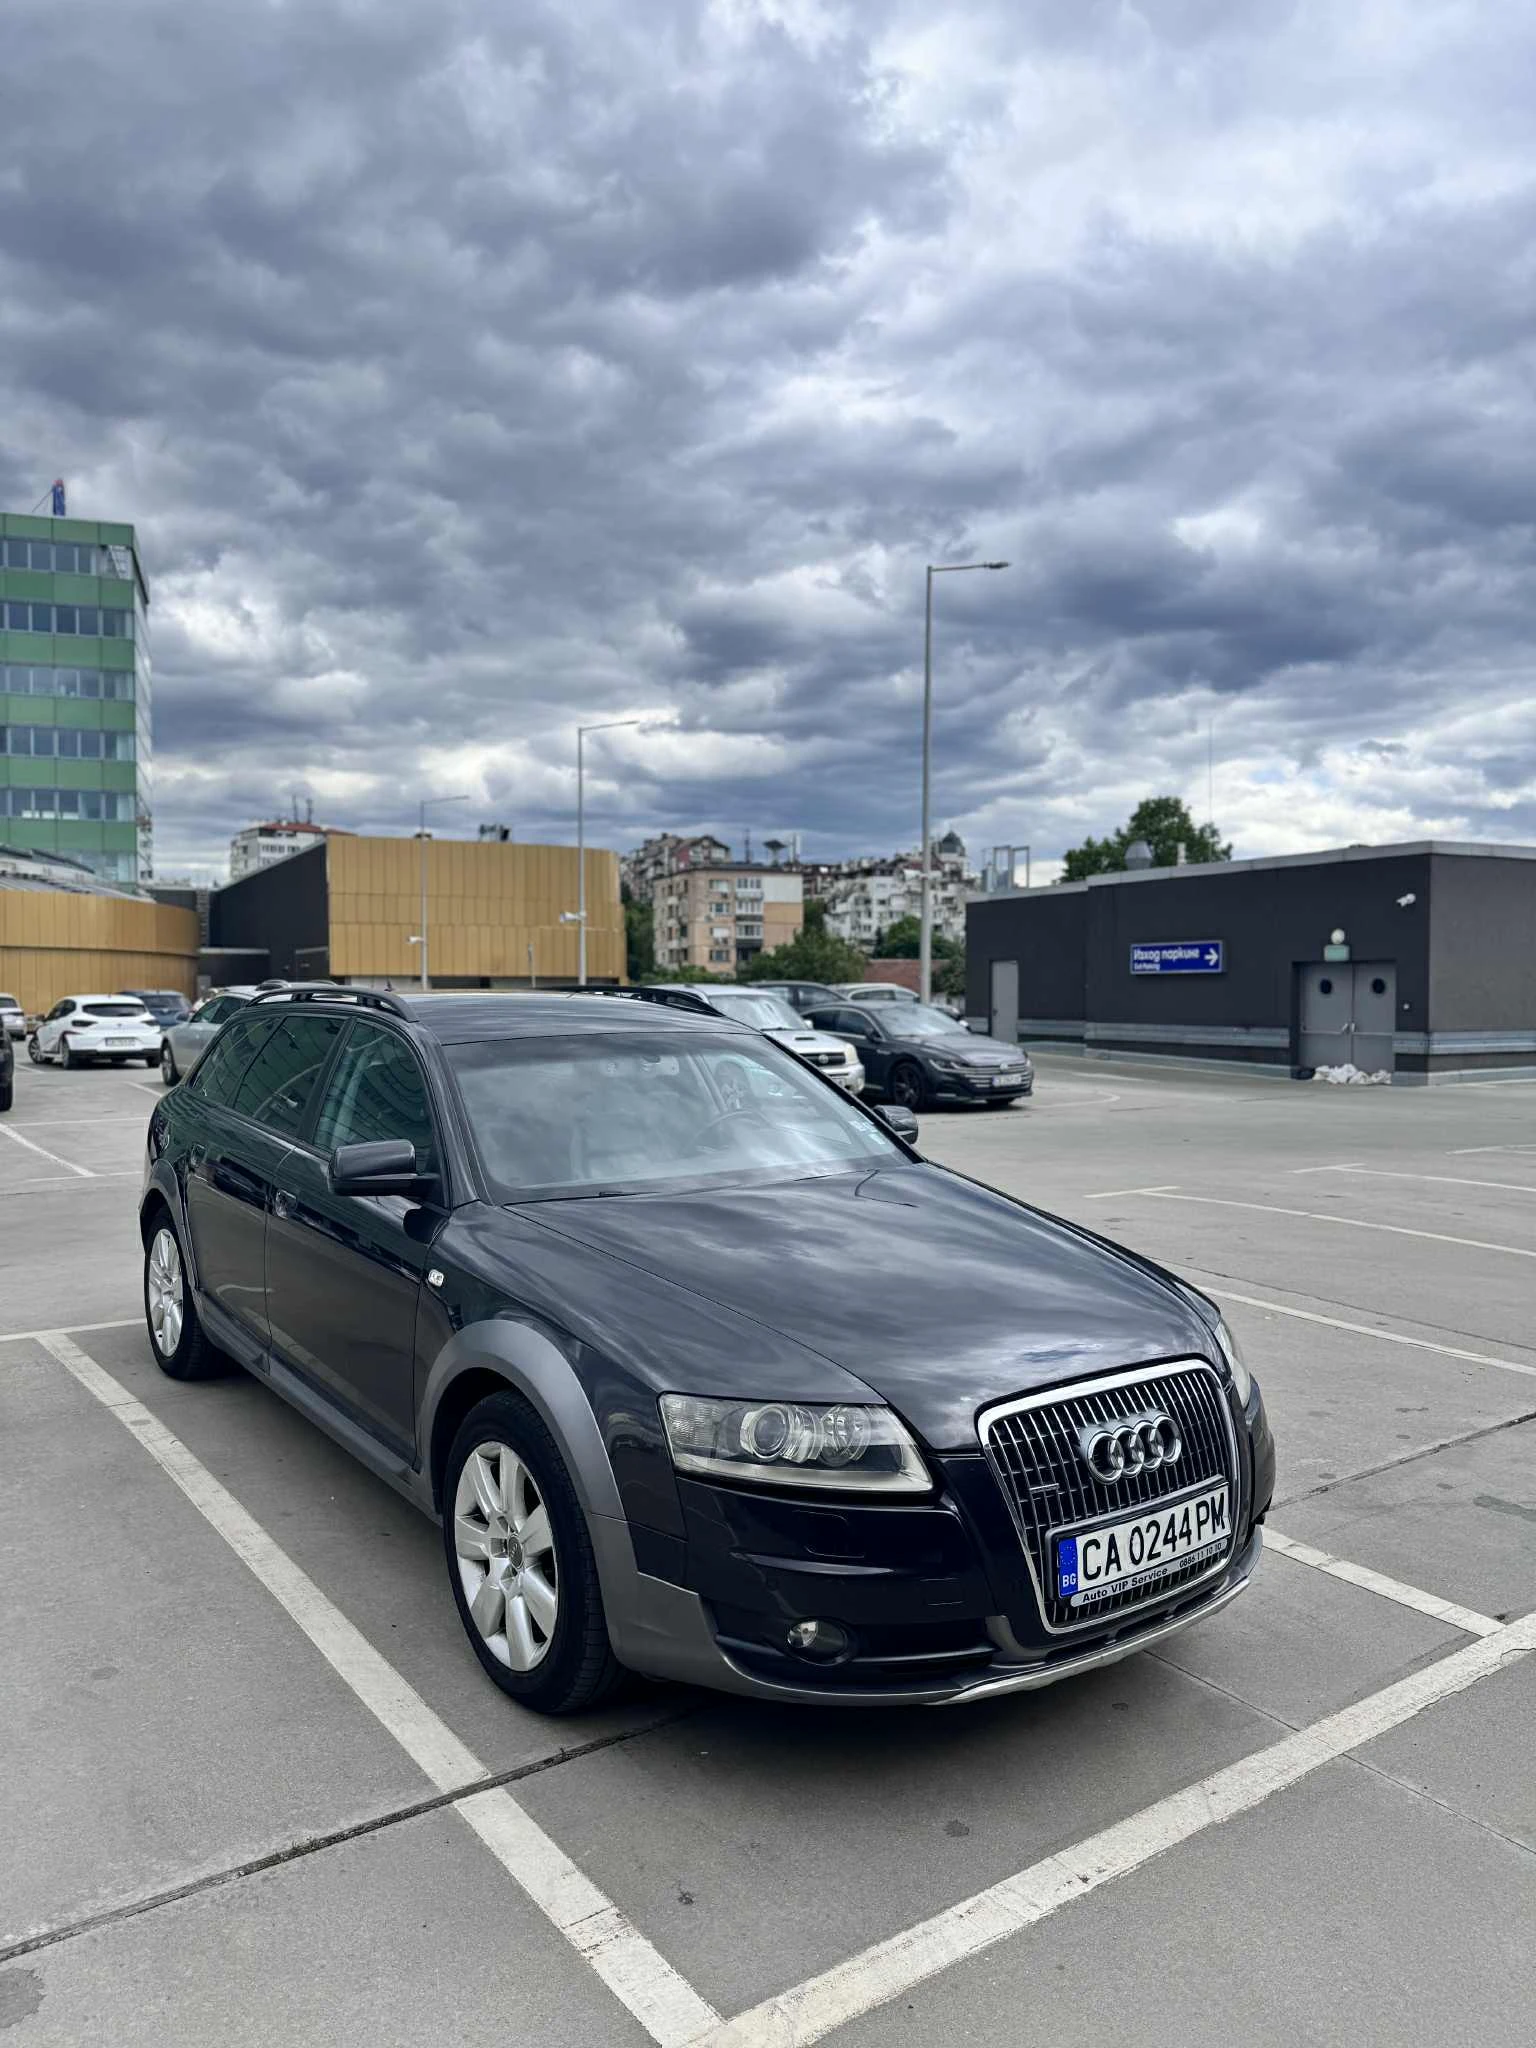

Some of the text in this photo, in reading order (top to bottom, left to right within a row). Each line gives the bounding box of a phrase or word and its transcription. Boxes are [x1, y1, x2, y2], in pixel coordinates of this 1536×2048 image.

[1062, 1573, 1077, 1588] BG
[1082, 1568, 1168, 1603] Auto VIP Service
